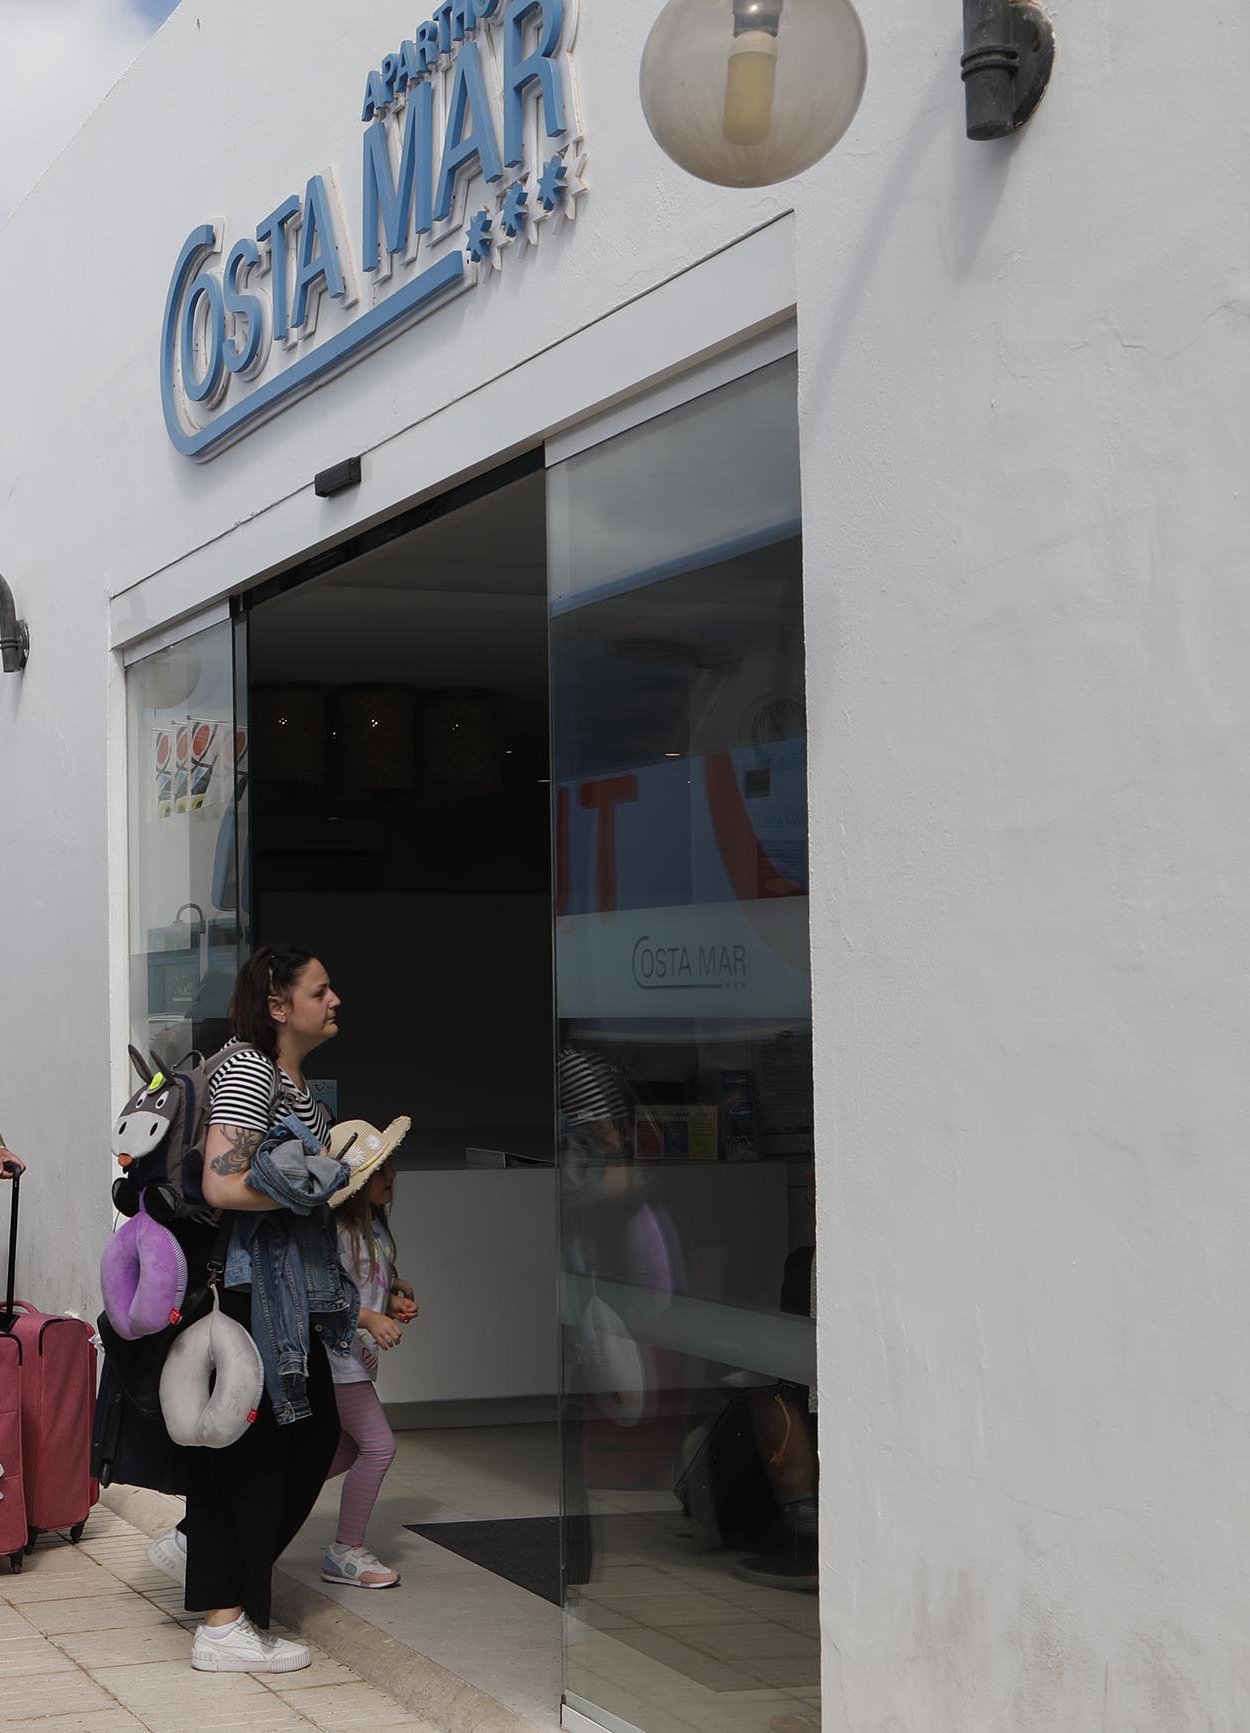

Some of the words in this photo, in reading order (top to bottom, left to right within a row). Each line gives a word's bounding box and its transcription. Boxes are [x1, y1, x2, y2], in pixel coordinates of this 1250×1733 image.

[160, 174, 346, 457] COSTA
[362, 0, 567, 274] MAR
[632, 936, 691, 990] COSTA
[698, 944, 747, 978] MAR
